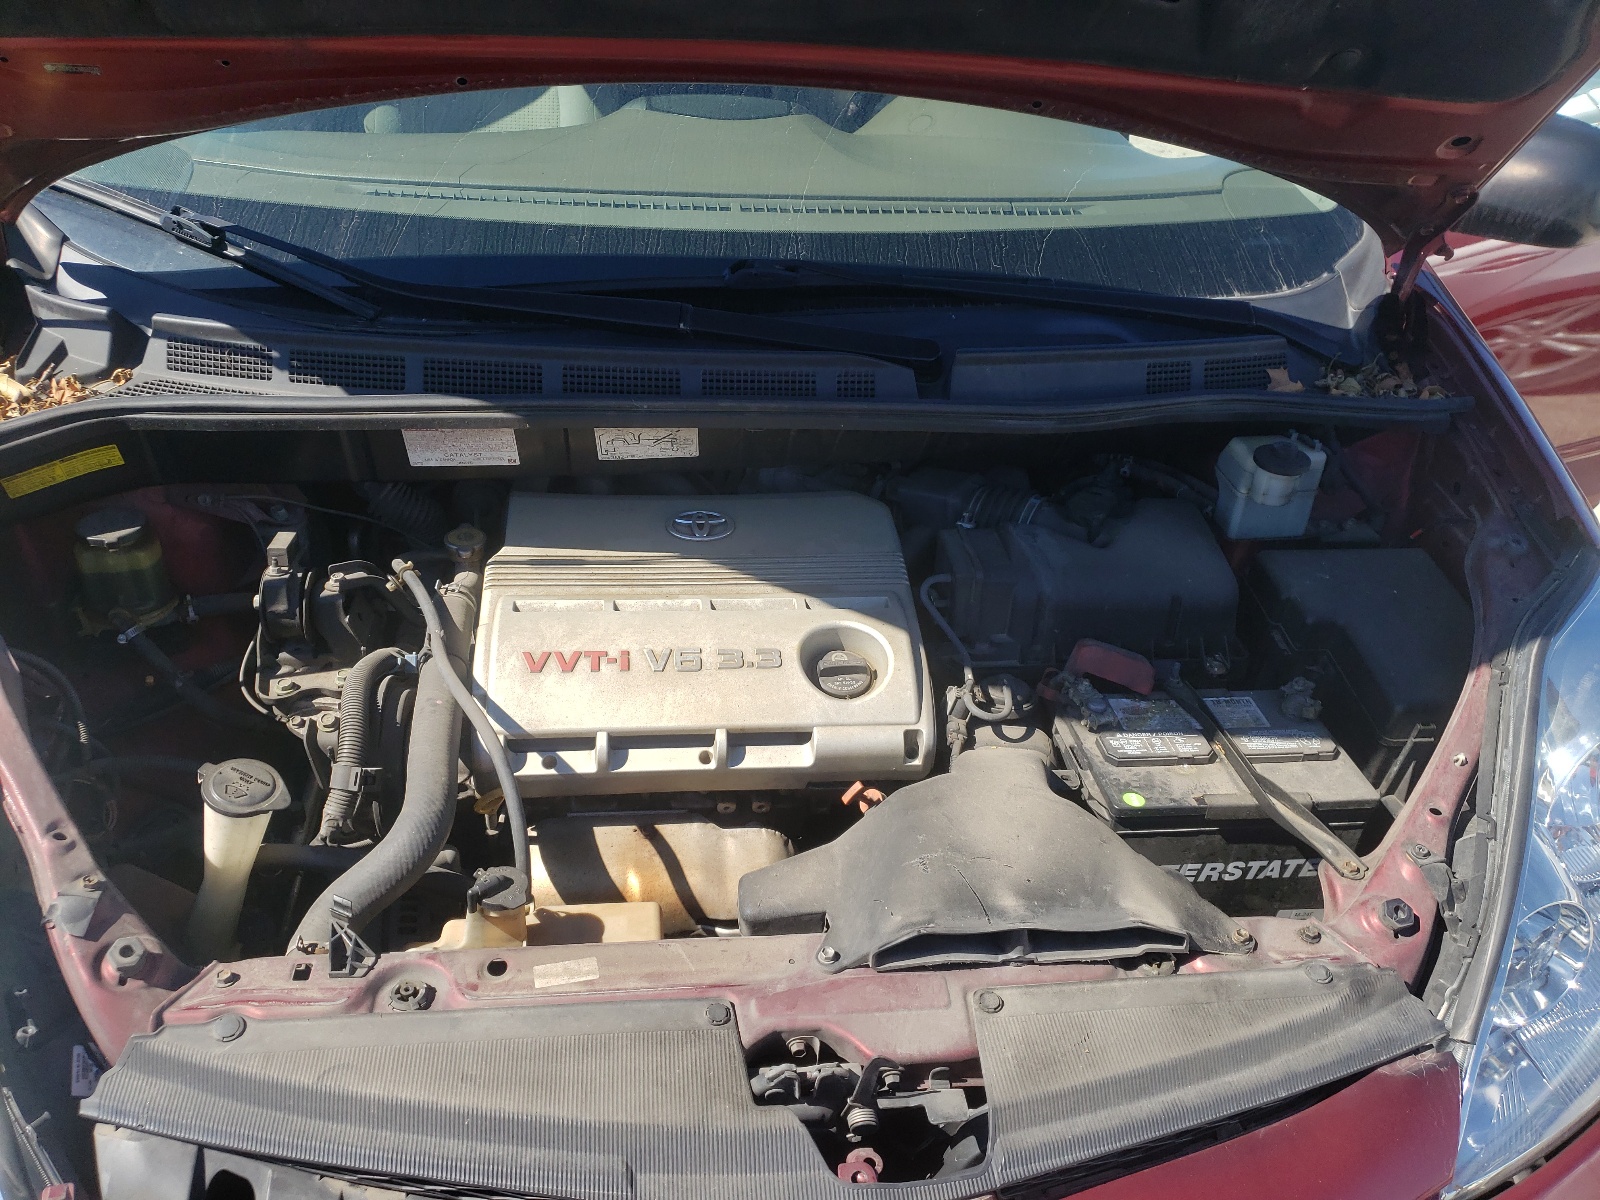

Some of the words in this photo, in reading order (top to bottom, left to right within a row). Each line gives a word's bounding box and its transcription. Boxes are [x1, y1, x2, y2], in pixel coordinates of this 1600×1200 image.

[522, 649, 630, 674] VVT-i
[643, 648, 703, 673] V6
[716, 647, 782, 670] 3.3
